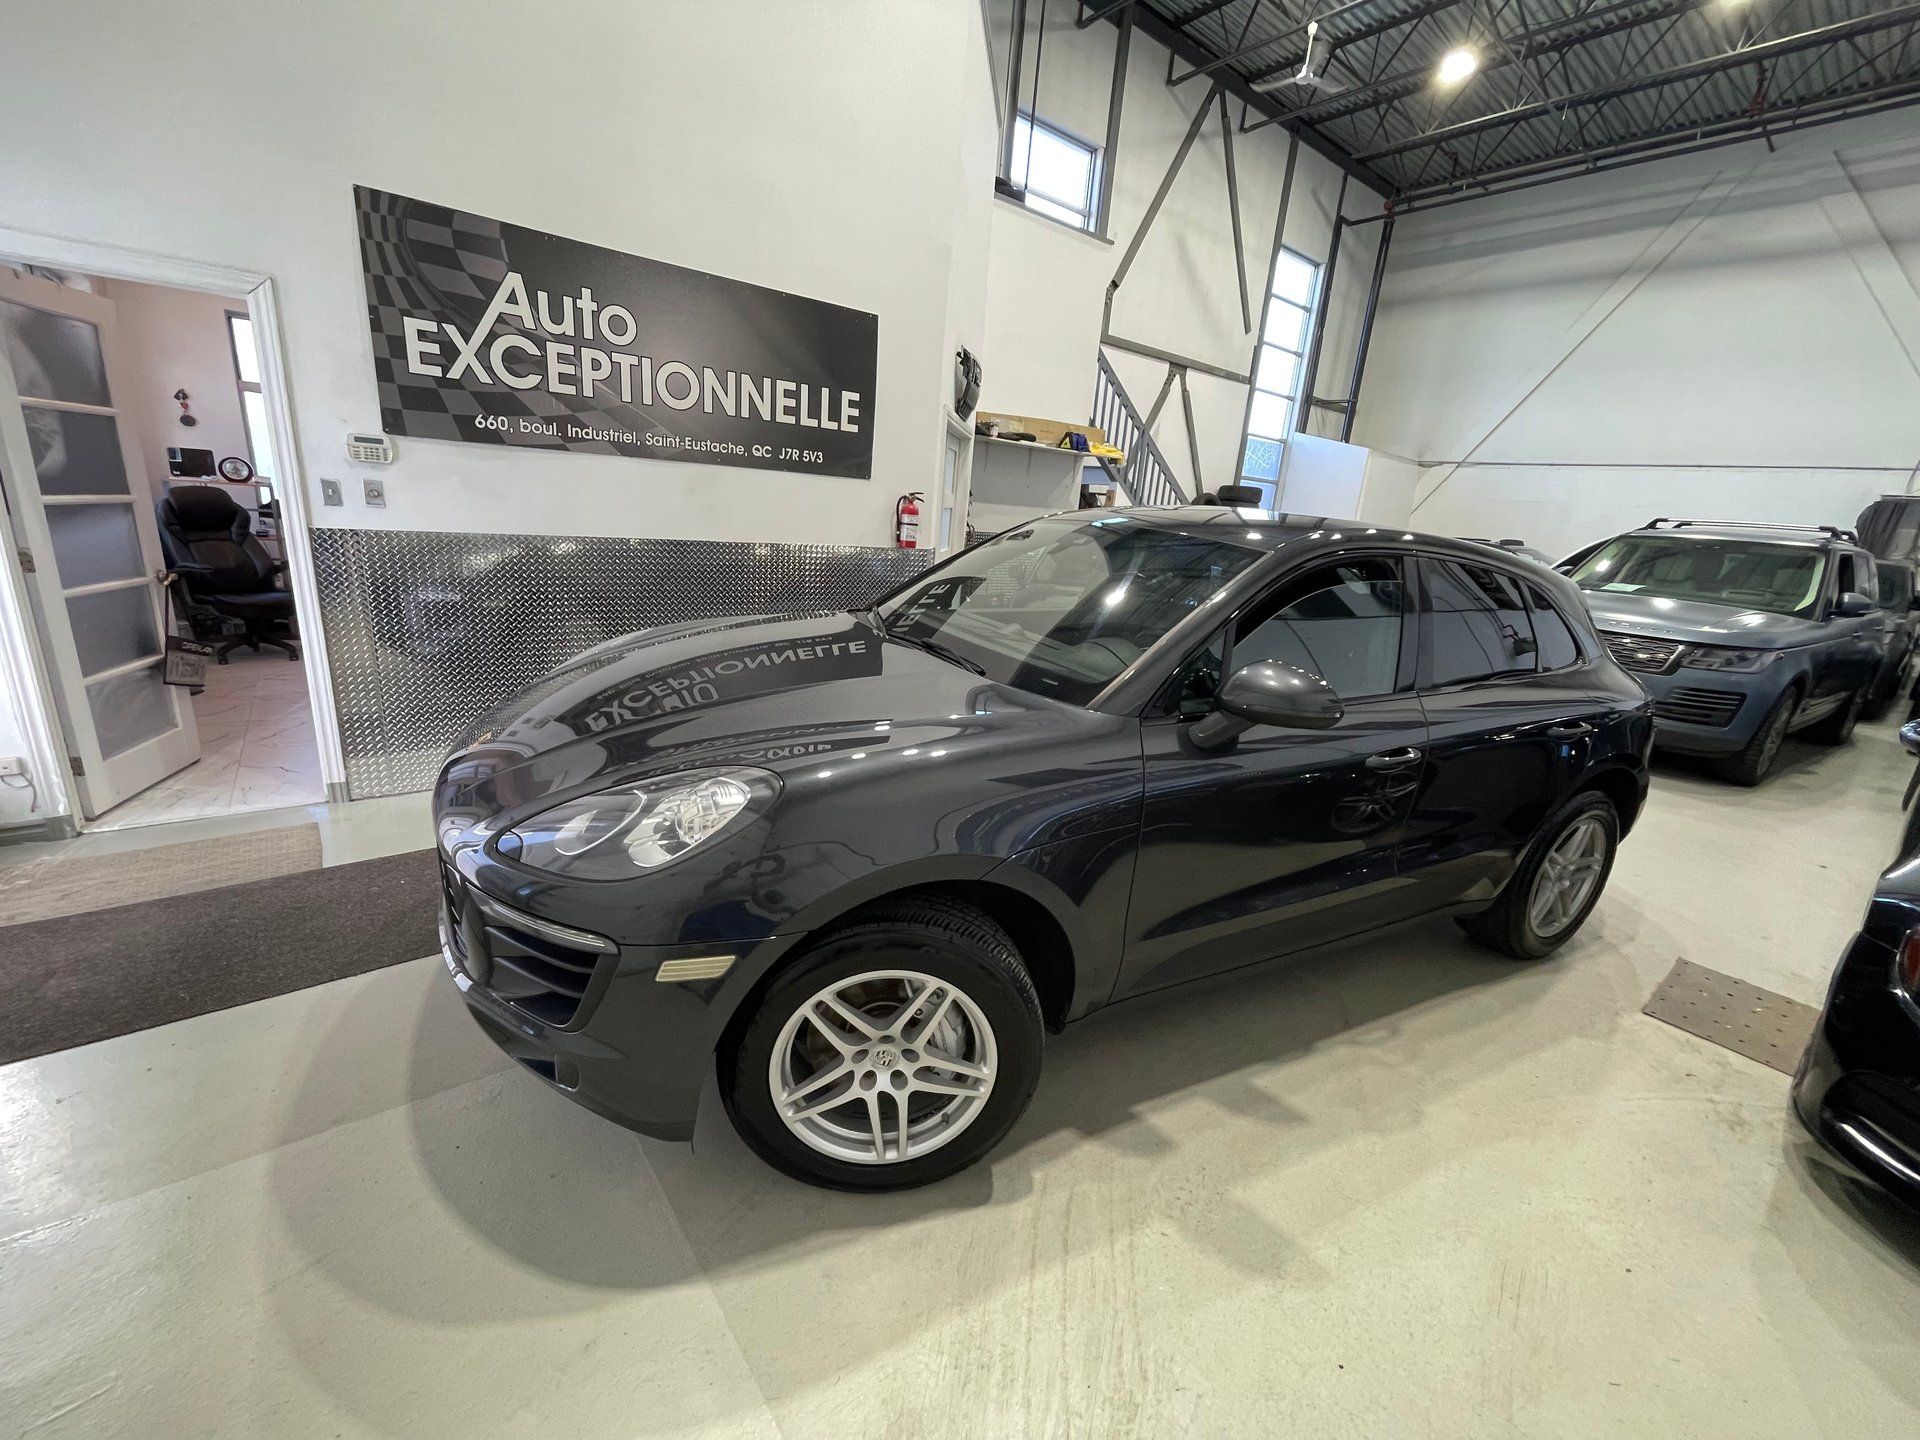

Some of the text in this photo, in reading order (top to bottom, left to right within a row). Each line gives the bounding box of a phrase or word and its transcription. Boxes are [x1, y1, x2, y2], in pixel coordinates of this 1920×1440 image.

[468, 271, 638, 346] Auto
[403, 316, 861, 433] EXCEPTIONNELLE
[474, 413, 824, 464] 660, boul. Industriel, Saint-Eustache, QC J7R 5V3
